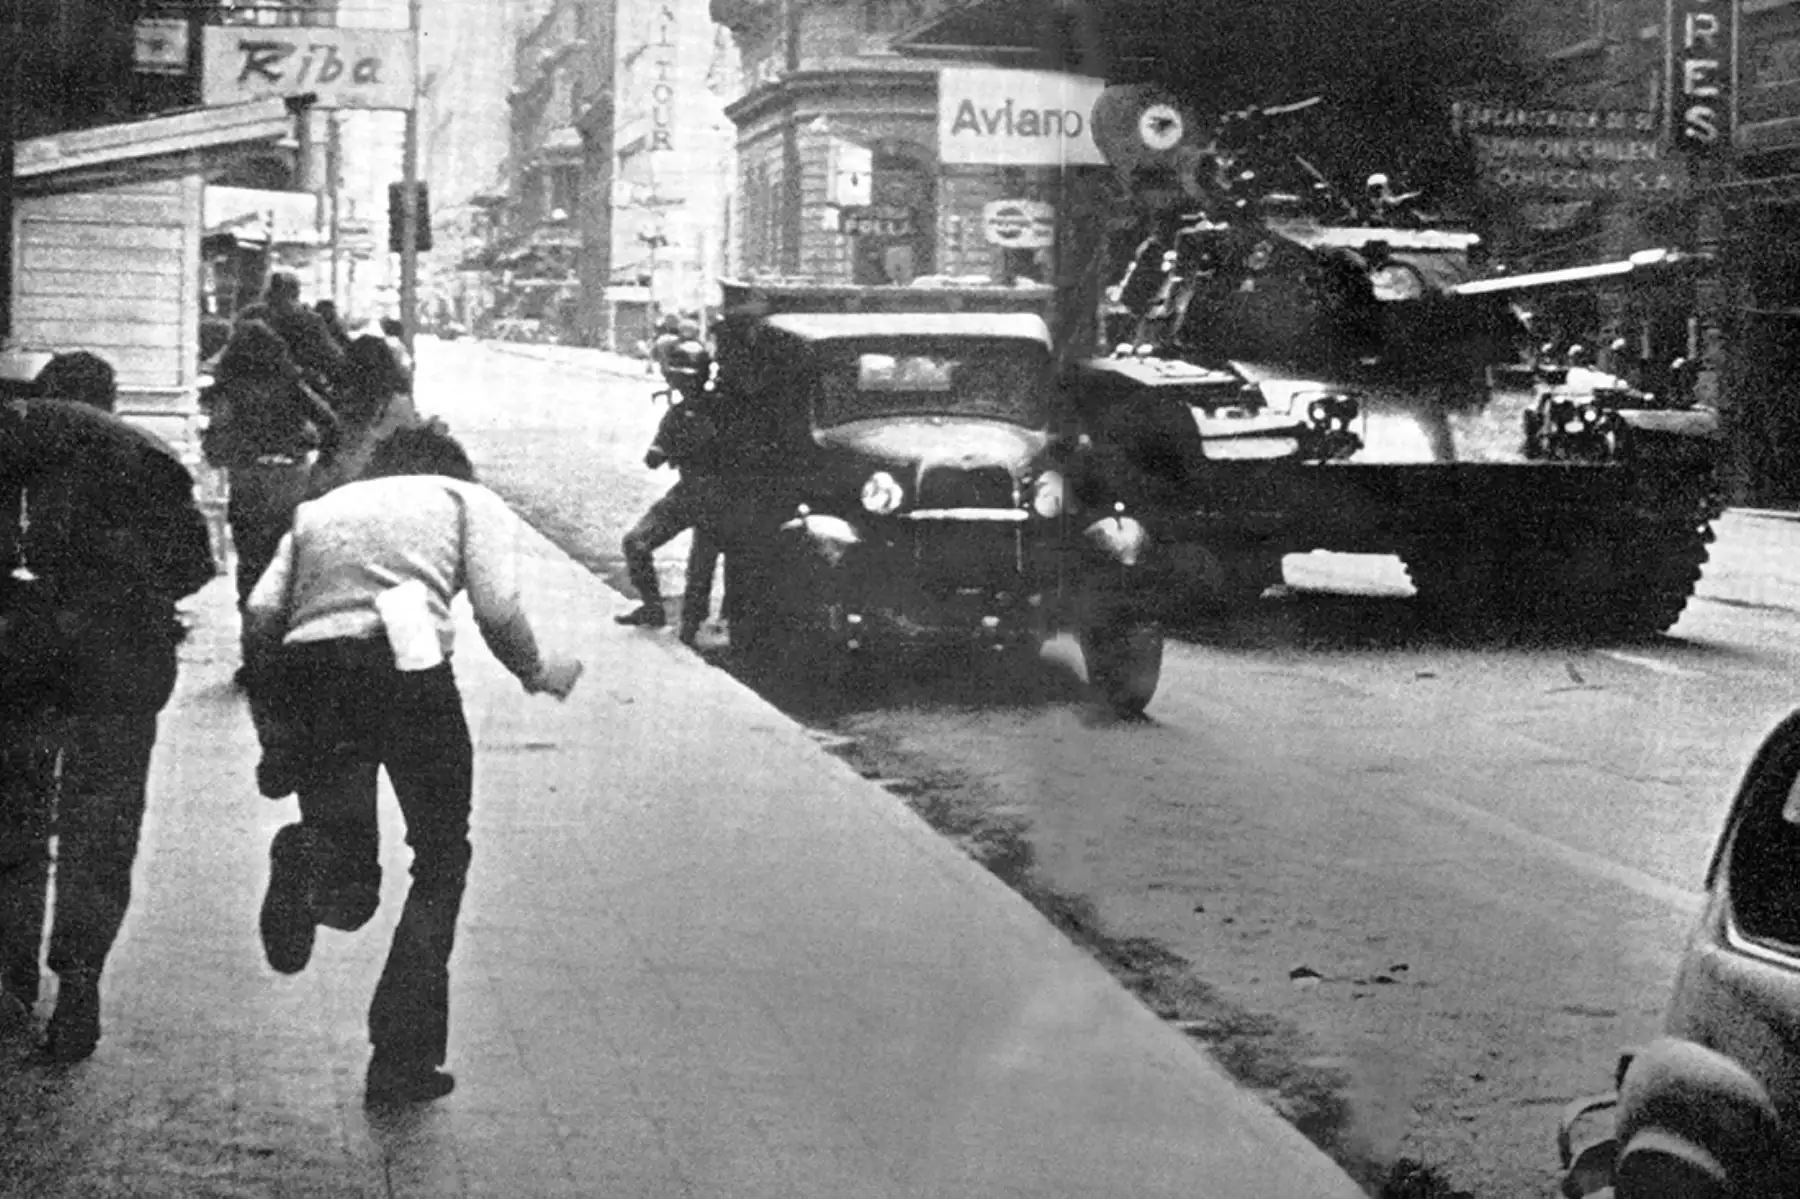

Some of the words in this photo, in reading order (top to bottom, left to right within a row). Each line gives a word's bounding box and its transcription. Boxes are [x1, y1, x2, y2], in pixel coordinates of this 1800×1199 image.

[236, 39, 383, 85] Riba
[1684, 0, 1720, 144] RES
[951, 98, 1083, 138] Aviano
